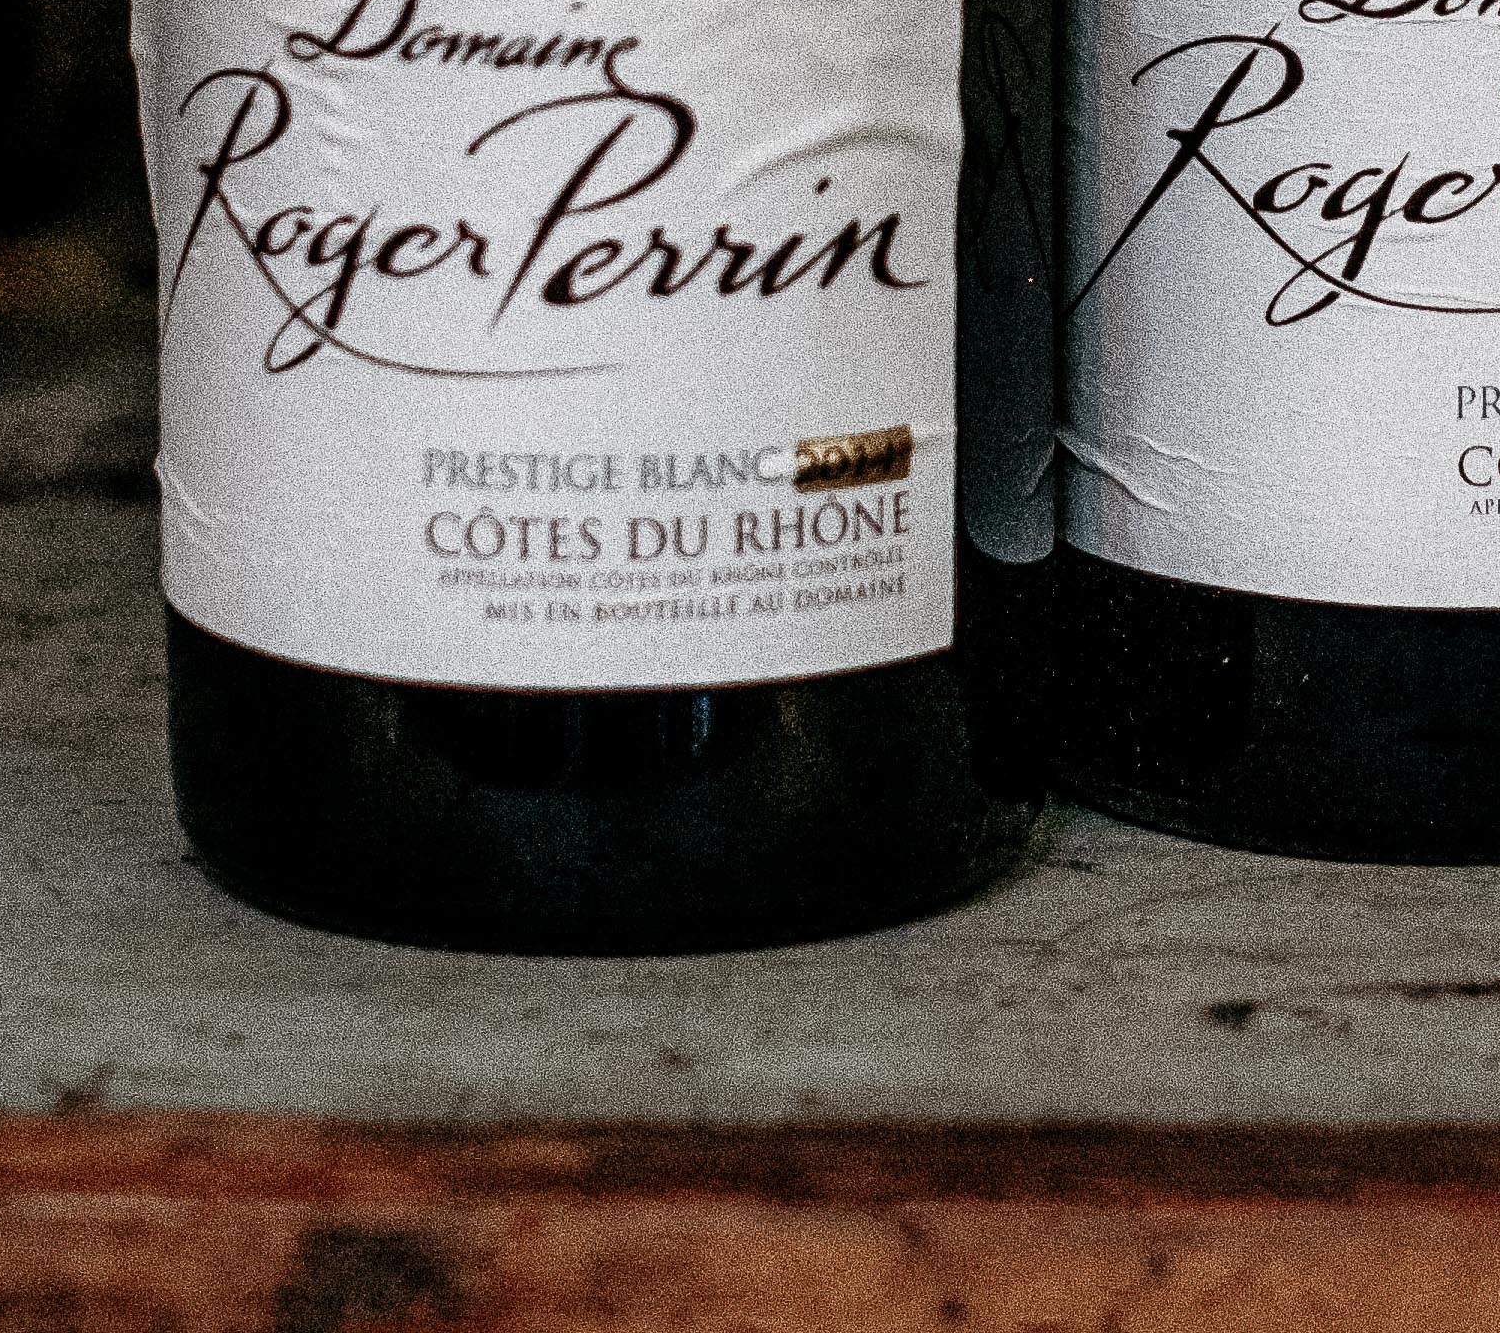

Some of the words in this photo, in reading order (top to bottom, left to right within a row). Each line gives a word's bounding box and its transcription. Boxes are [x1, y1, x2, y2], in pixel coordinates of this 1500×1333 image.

[164, 65, 500, 377] Roger
[467, 89, 930, 331] Perrin
[421, 445, 623, 494] PRESTIGE
[637, 443, 787, 494] BLANC
[422, 504, 603, 565] CÔTES
[624, 514, 711, 564] DU
[732, 489, 912, 558] RHÔNE
[482, 600, 535, 625] MIS
[543, 599, 583, 624] EN
[592, 592, 740, 625] BOUTEILLE
[746, 586, 786, 615] AU
[791, 568, 908, 612] DOMAINE
